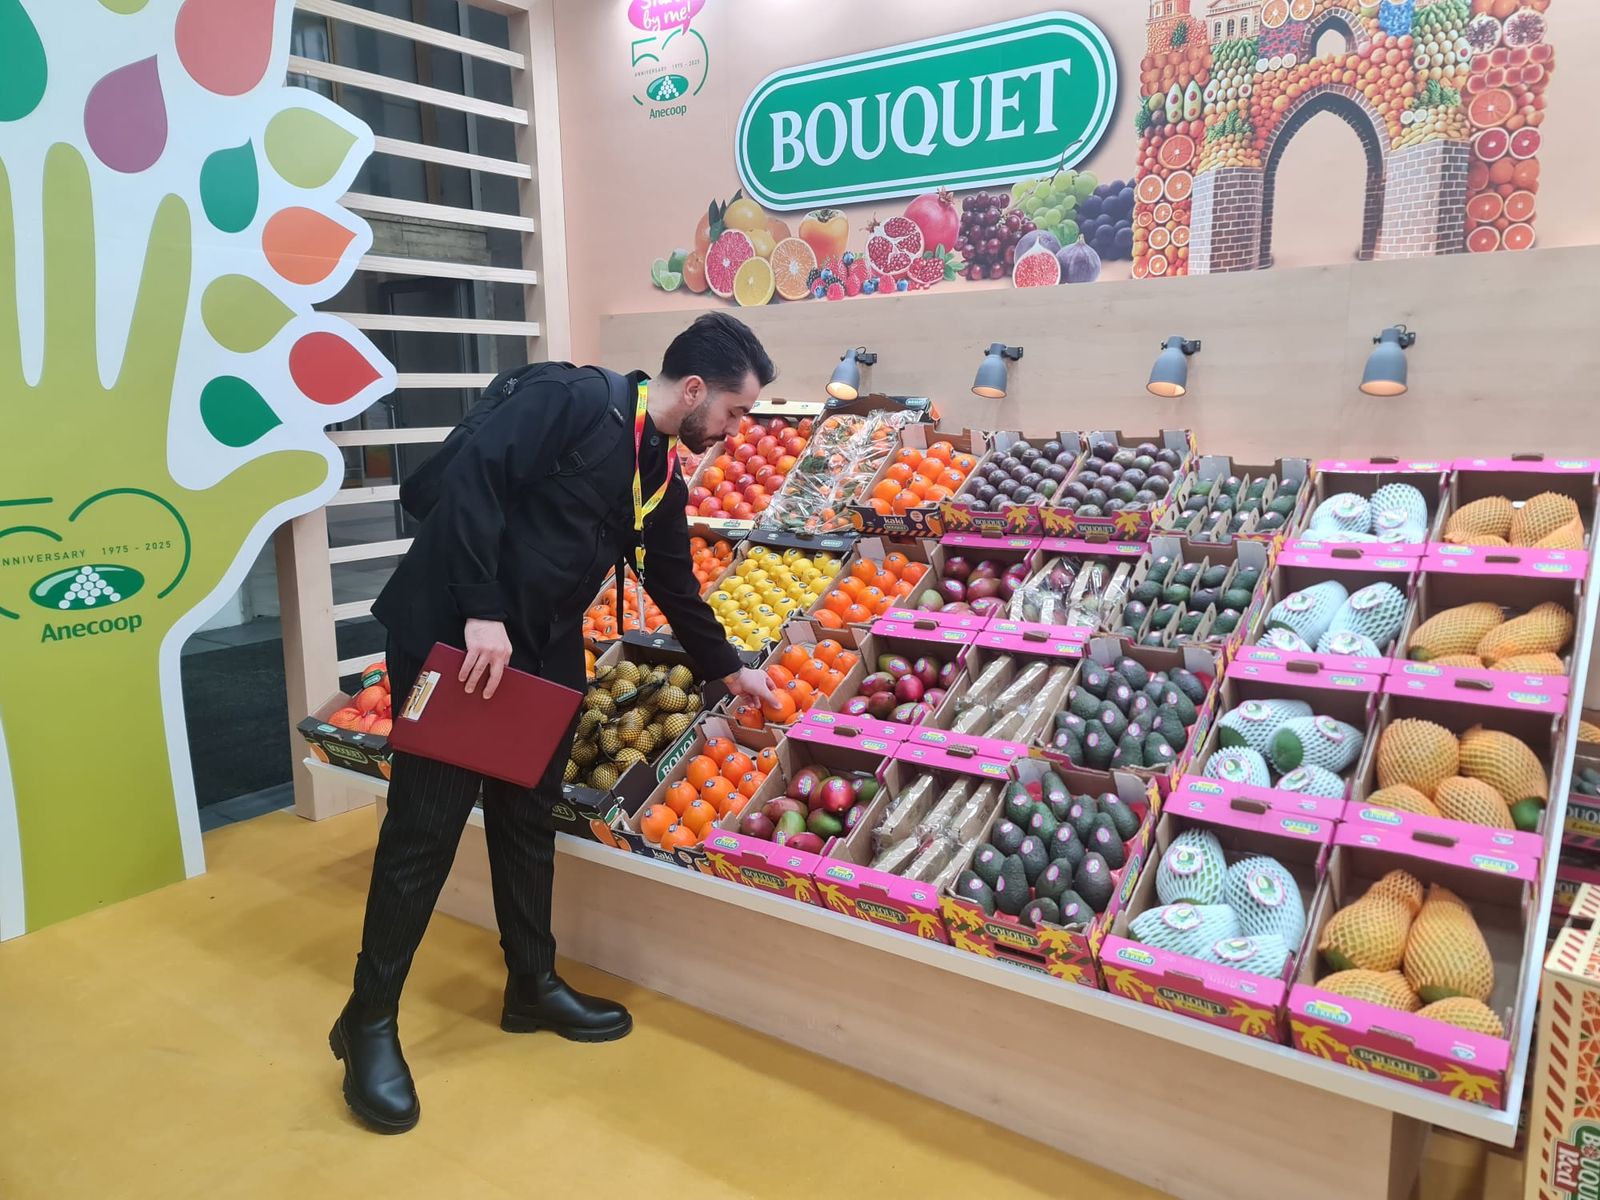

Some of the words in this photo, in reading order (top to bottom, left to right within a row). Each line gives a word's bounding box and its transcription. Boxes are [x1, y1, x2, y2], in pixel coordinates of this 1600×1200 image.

[649, 105, 687, 119] Anecoop
[769, 58, 1071, 173] BOUQUET
[975, 518, 1007, 528] BOUQUET
[1079, 524, 1115, 534] BOUQUET
[0, 549, 86, 566] NNIVERSARY
[102, 545, 129, 556] 1975
[145, 540, 172, 551] 2025
[41, 614, 143, 643] Anecoop
[859, 901, 903, 921] BOUQUET
[989, 925, 1035, 945] BOUQUET
[1162, 989, 1221, 1013] BOUQUET
[1358, 1050, 1427, 1078] BOUQUET
